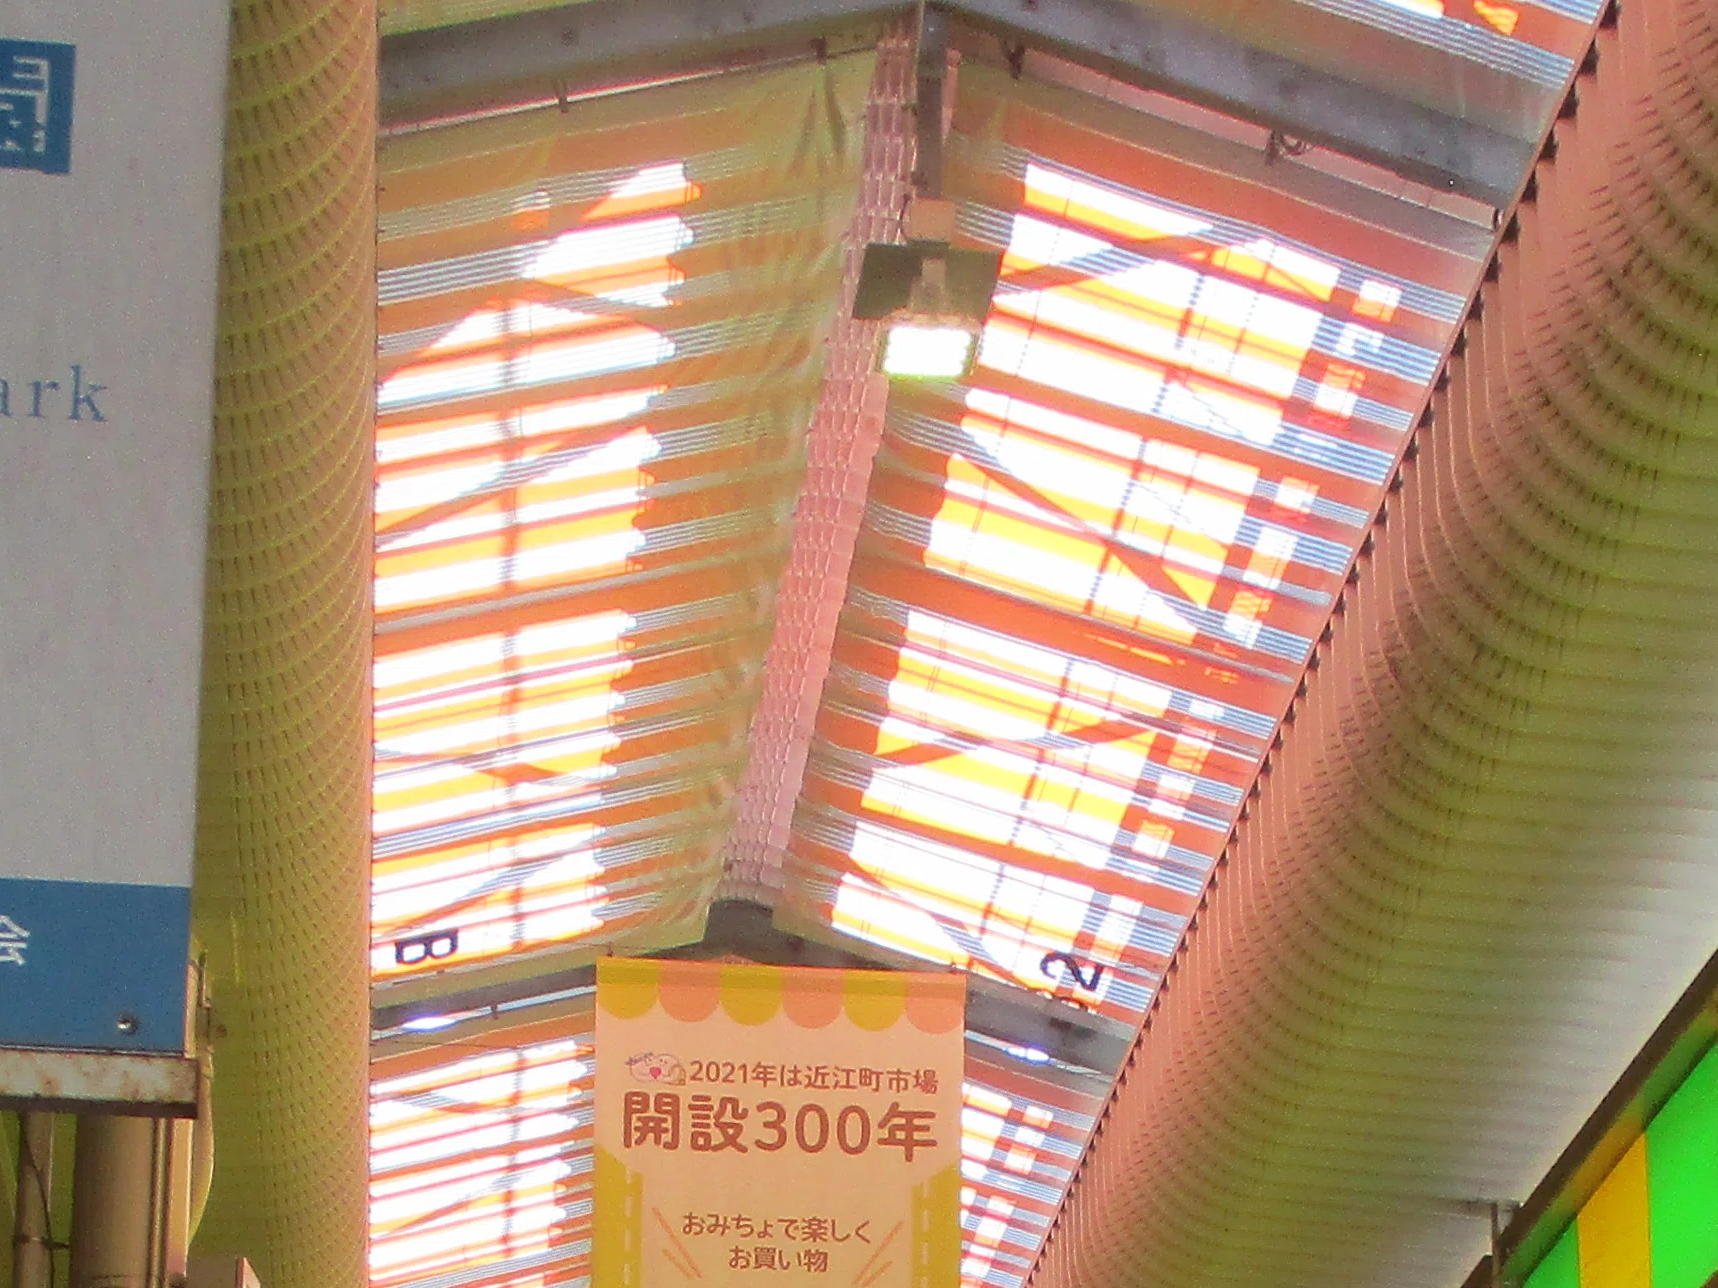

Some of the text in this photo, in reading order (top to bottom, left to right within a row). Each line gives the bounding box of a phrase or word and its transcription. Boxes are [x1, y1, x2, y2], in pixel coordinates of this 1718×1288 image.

[689, 1060, 939, 1095] 2021年は近江町市場
[622, 1090, 938, 1163] 開設300年
[682, 1211, 872, 1245] おみちょで楽しく
[728, 1246, 829, 1273] お買い物
